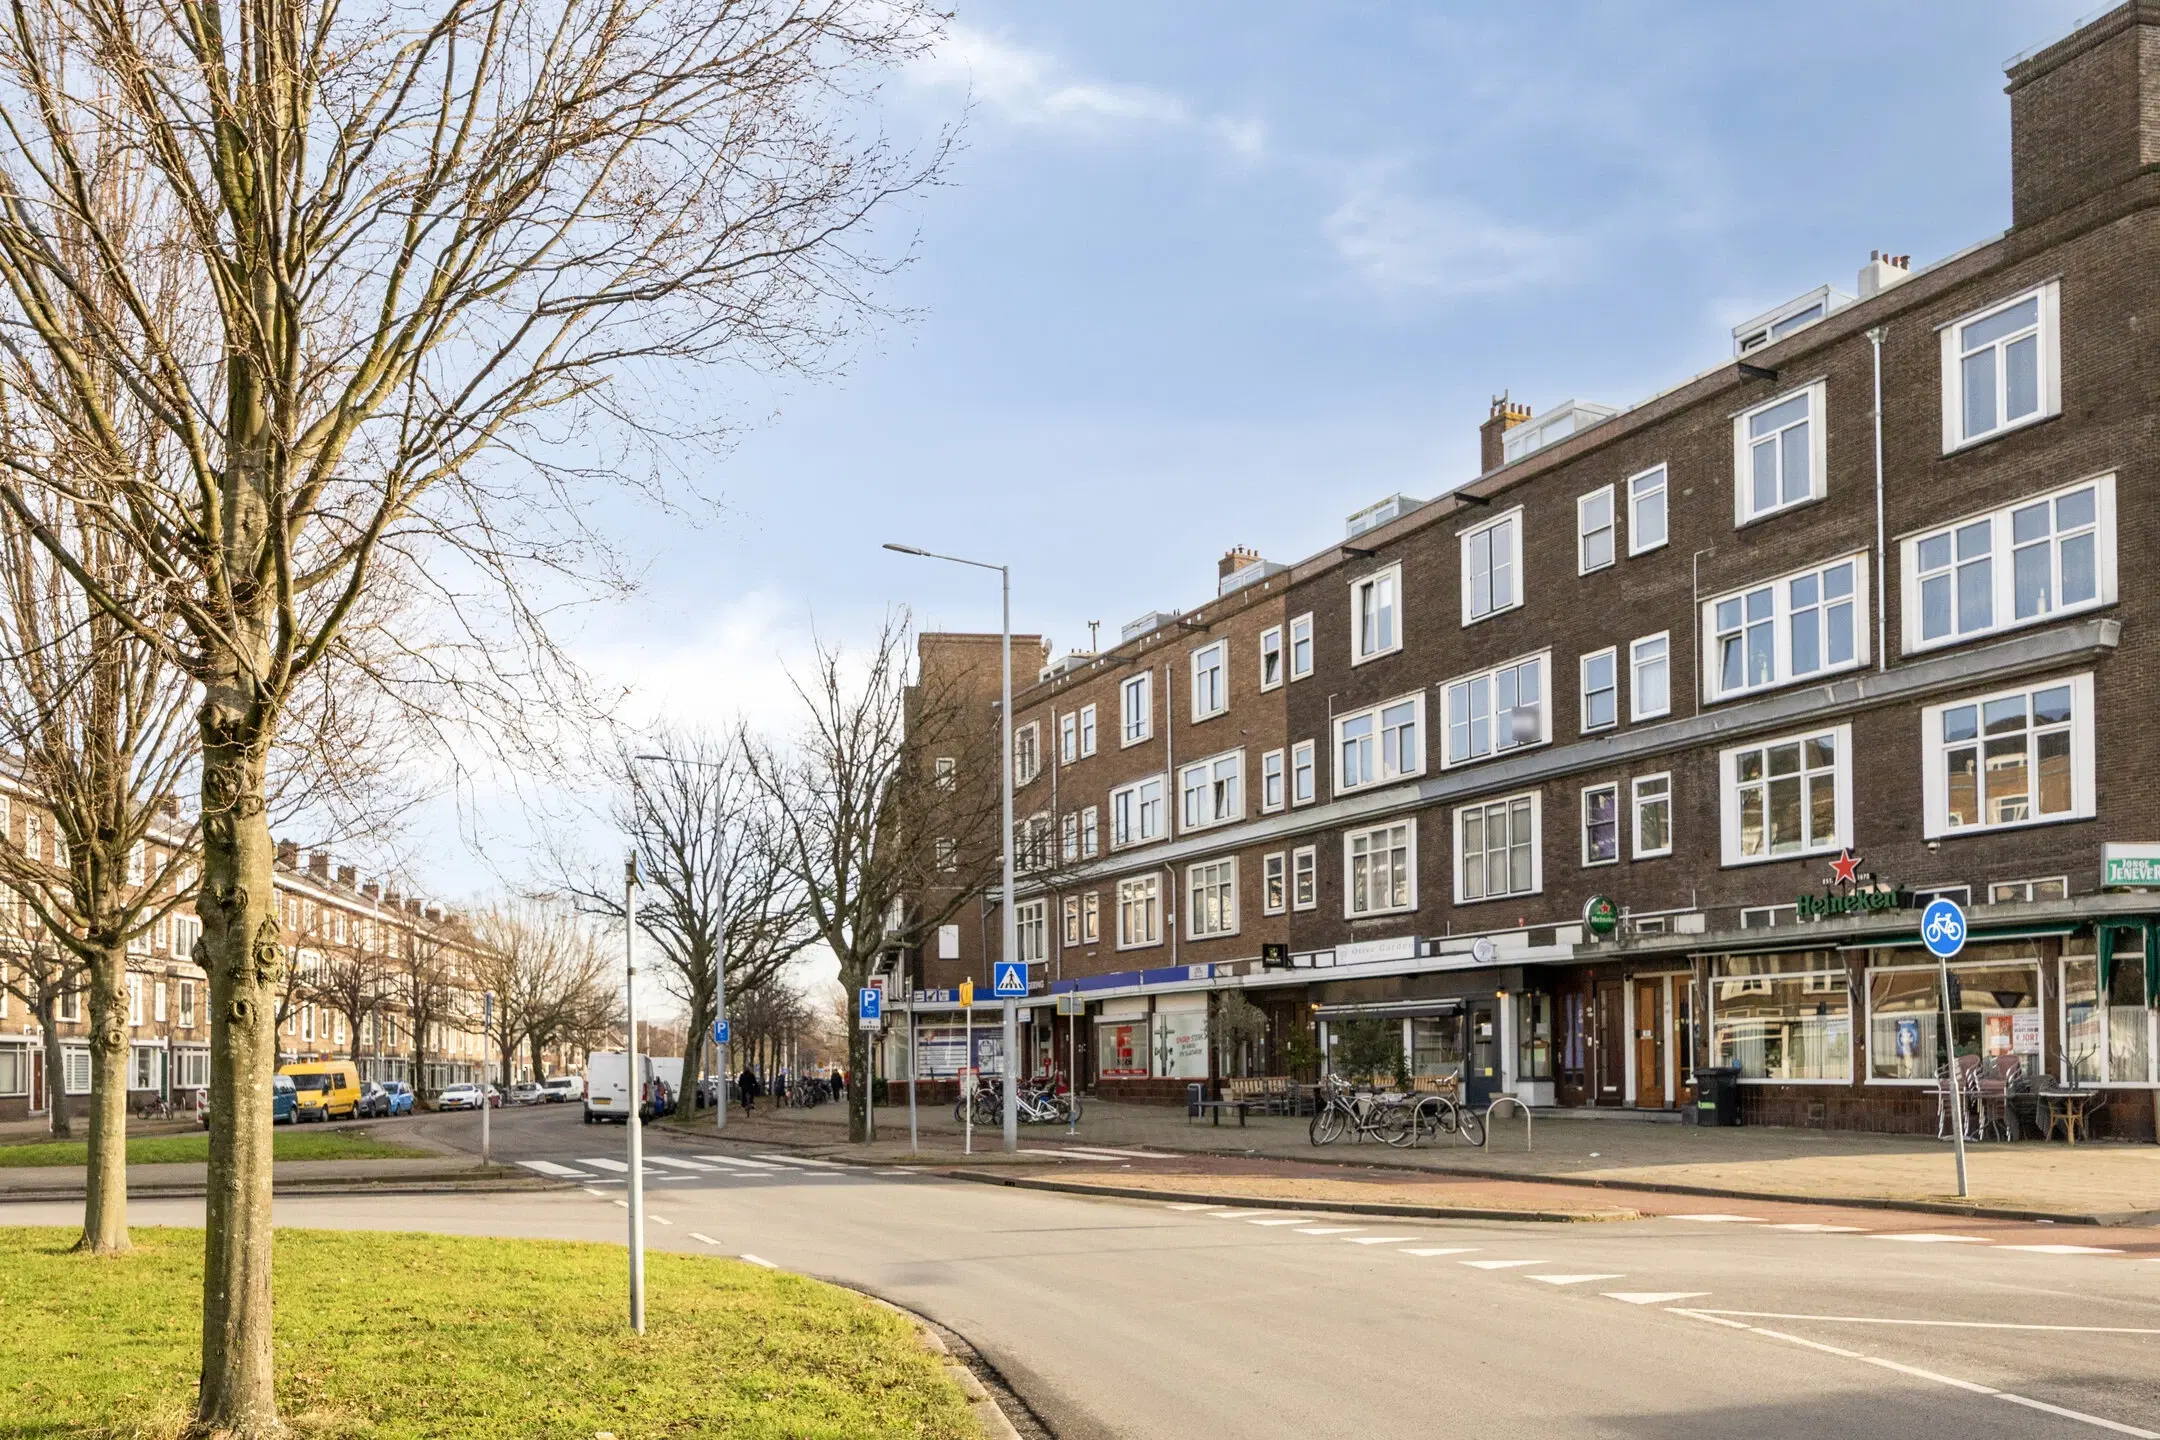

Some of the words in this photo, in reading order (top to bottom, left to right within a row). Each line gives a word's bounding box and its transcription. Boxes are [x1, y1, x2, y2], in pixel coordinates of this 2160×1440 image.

[2110, 864, 2160, 881] JENEVER
[1797, 889, 1898, 916] Heineken
[864, 991, 876, 1007] P
[717, 1022, 726, 1033] P
